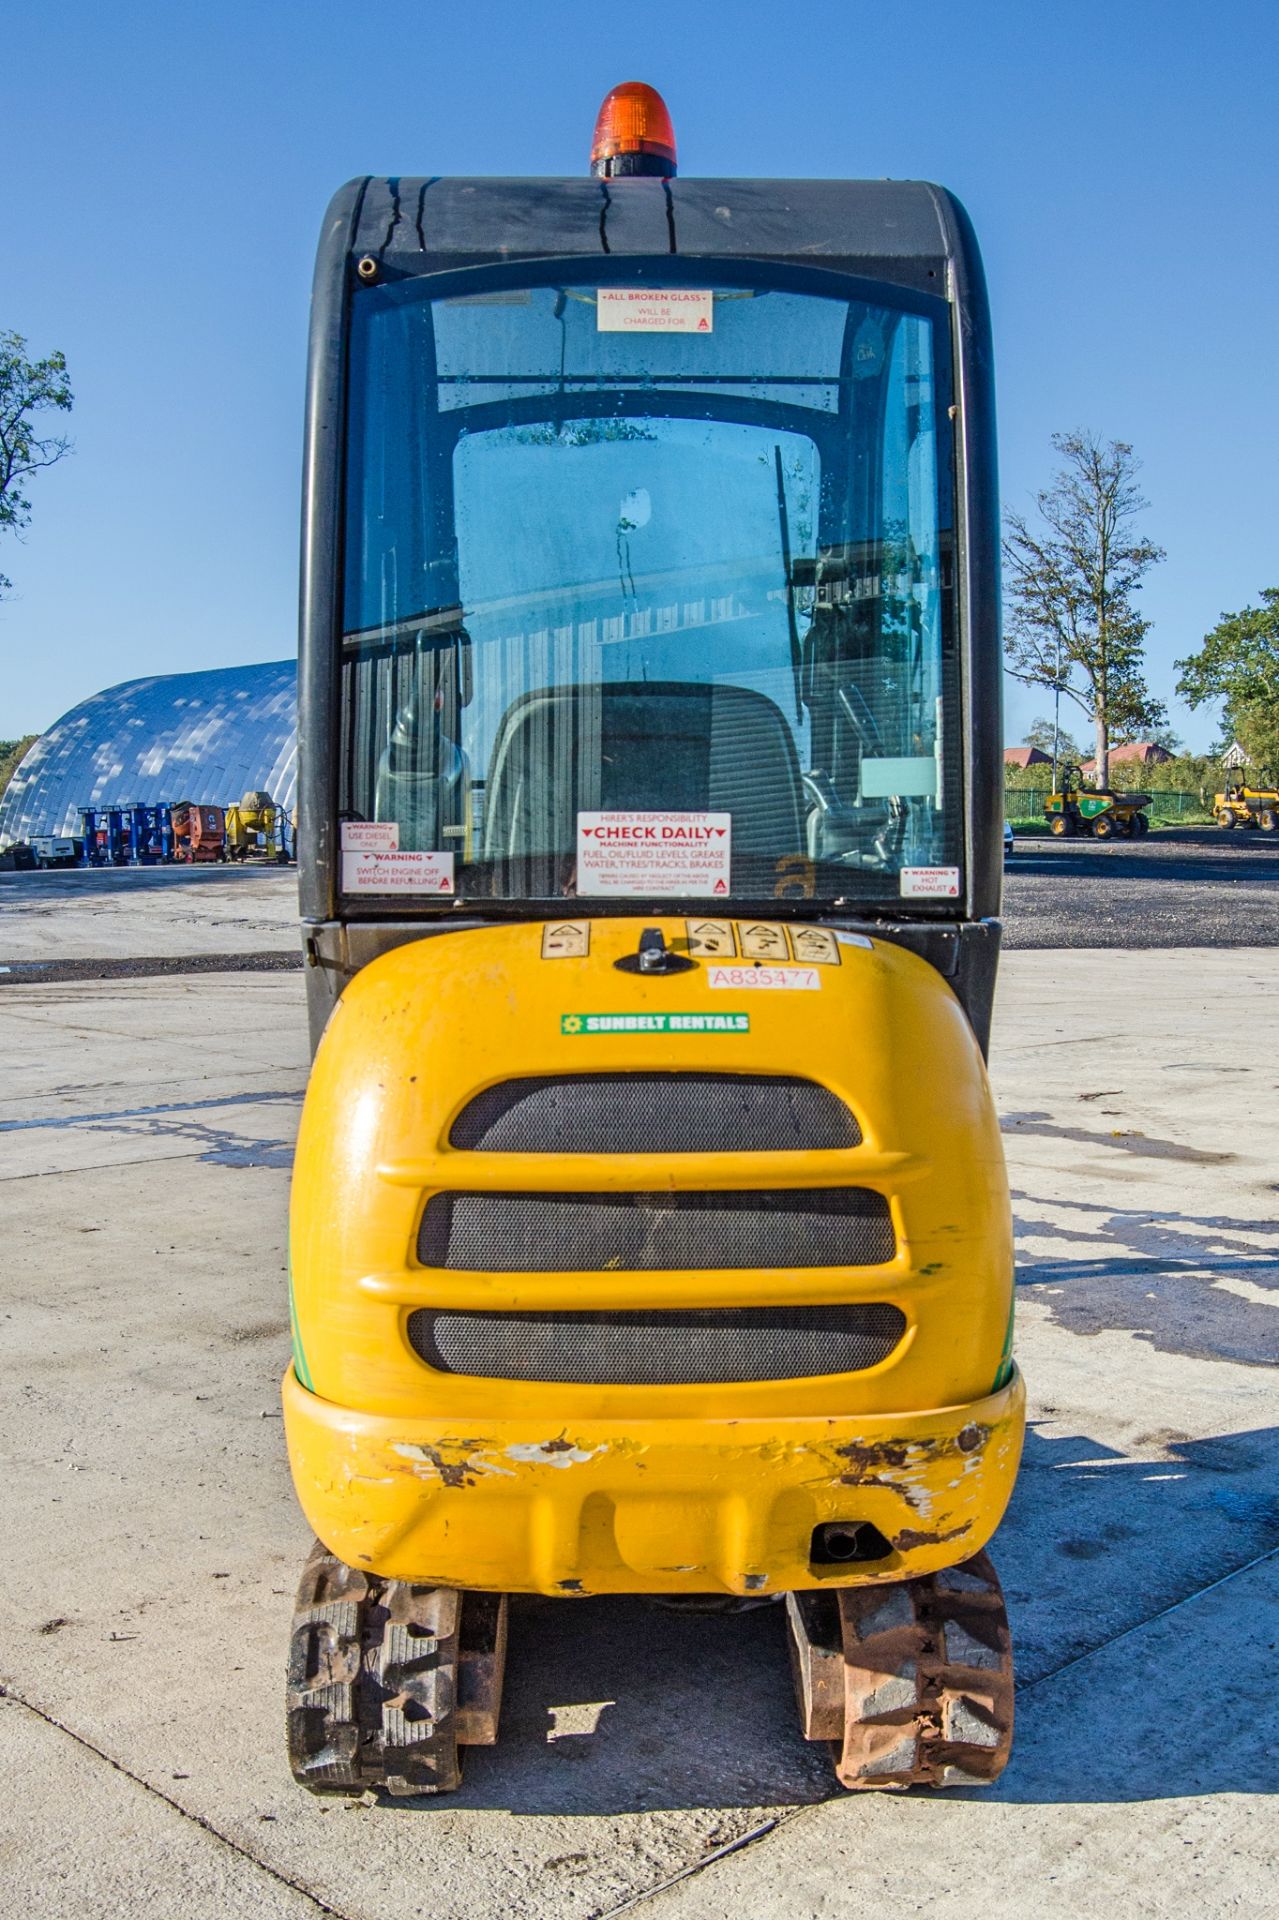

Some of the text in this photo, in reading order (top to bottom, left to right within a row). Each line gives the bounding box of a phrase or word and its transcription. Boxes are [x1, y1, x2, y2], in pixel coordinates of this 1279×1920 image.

[607, 293, 700, 302] ALL BROKEN GLASS
[638, 308, 658, 316] WILL
[623, 317, 666, 326] CHARGED
[601, 814, 708, 823] HIRER'S RESPONSIBILITY
[348, 832, 391, 840] USE DIESEL
[594, 827, 714, 839] CHECK DAILY
[375, 854, 423, 862] WARNING
[690, 850, 725, 859] GREASE
[689, 860, 724, 869] BRAKES
[391, 868, 422, 876] ENGINE
[424, 868, 440, 876] OFF
[358, 877, 437, 886] BEFORE REFUELLING
[713, 968, 814, 985] A835477
[586, 1015, 749, 1031] SUNBELT RENTALS
